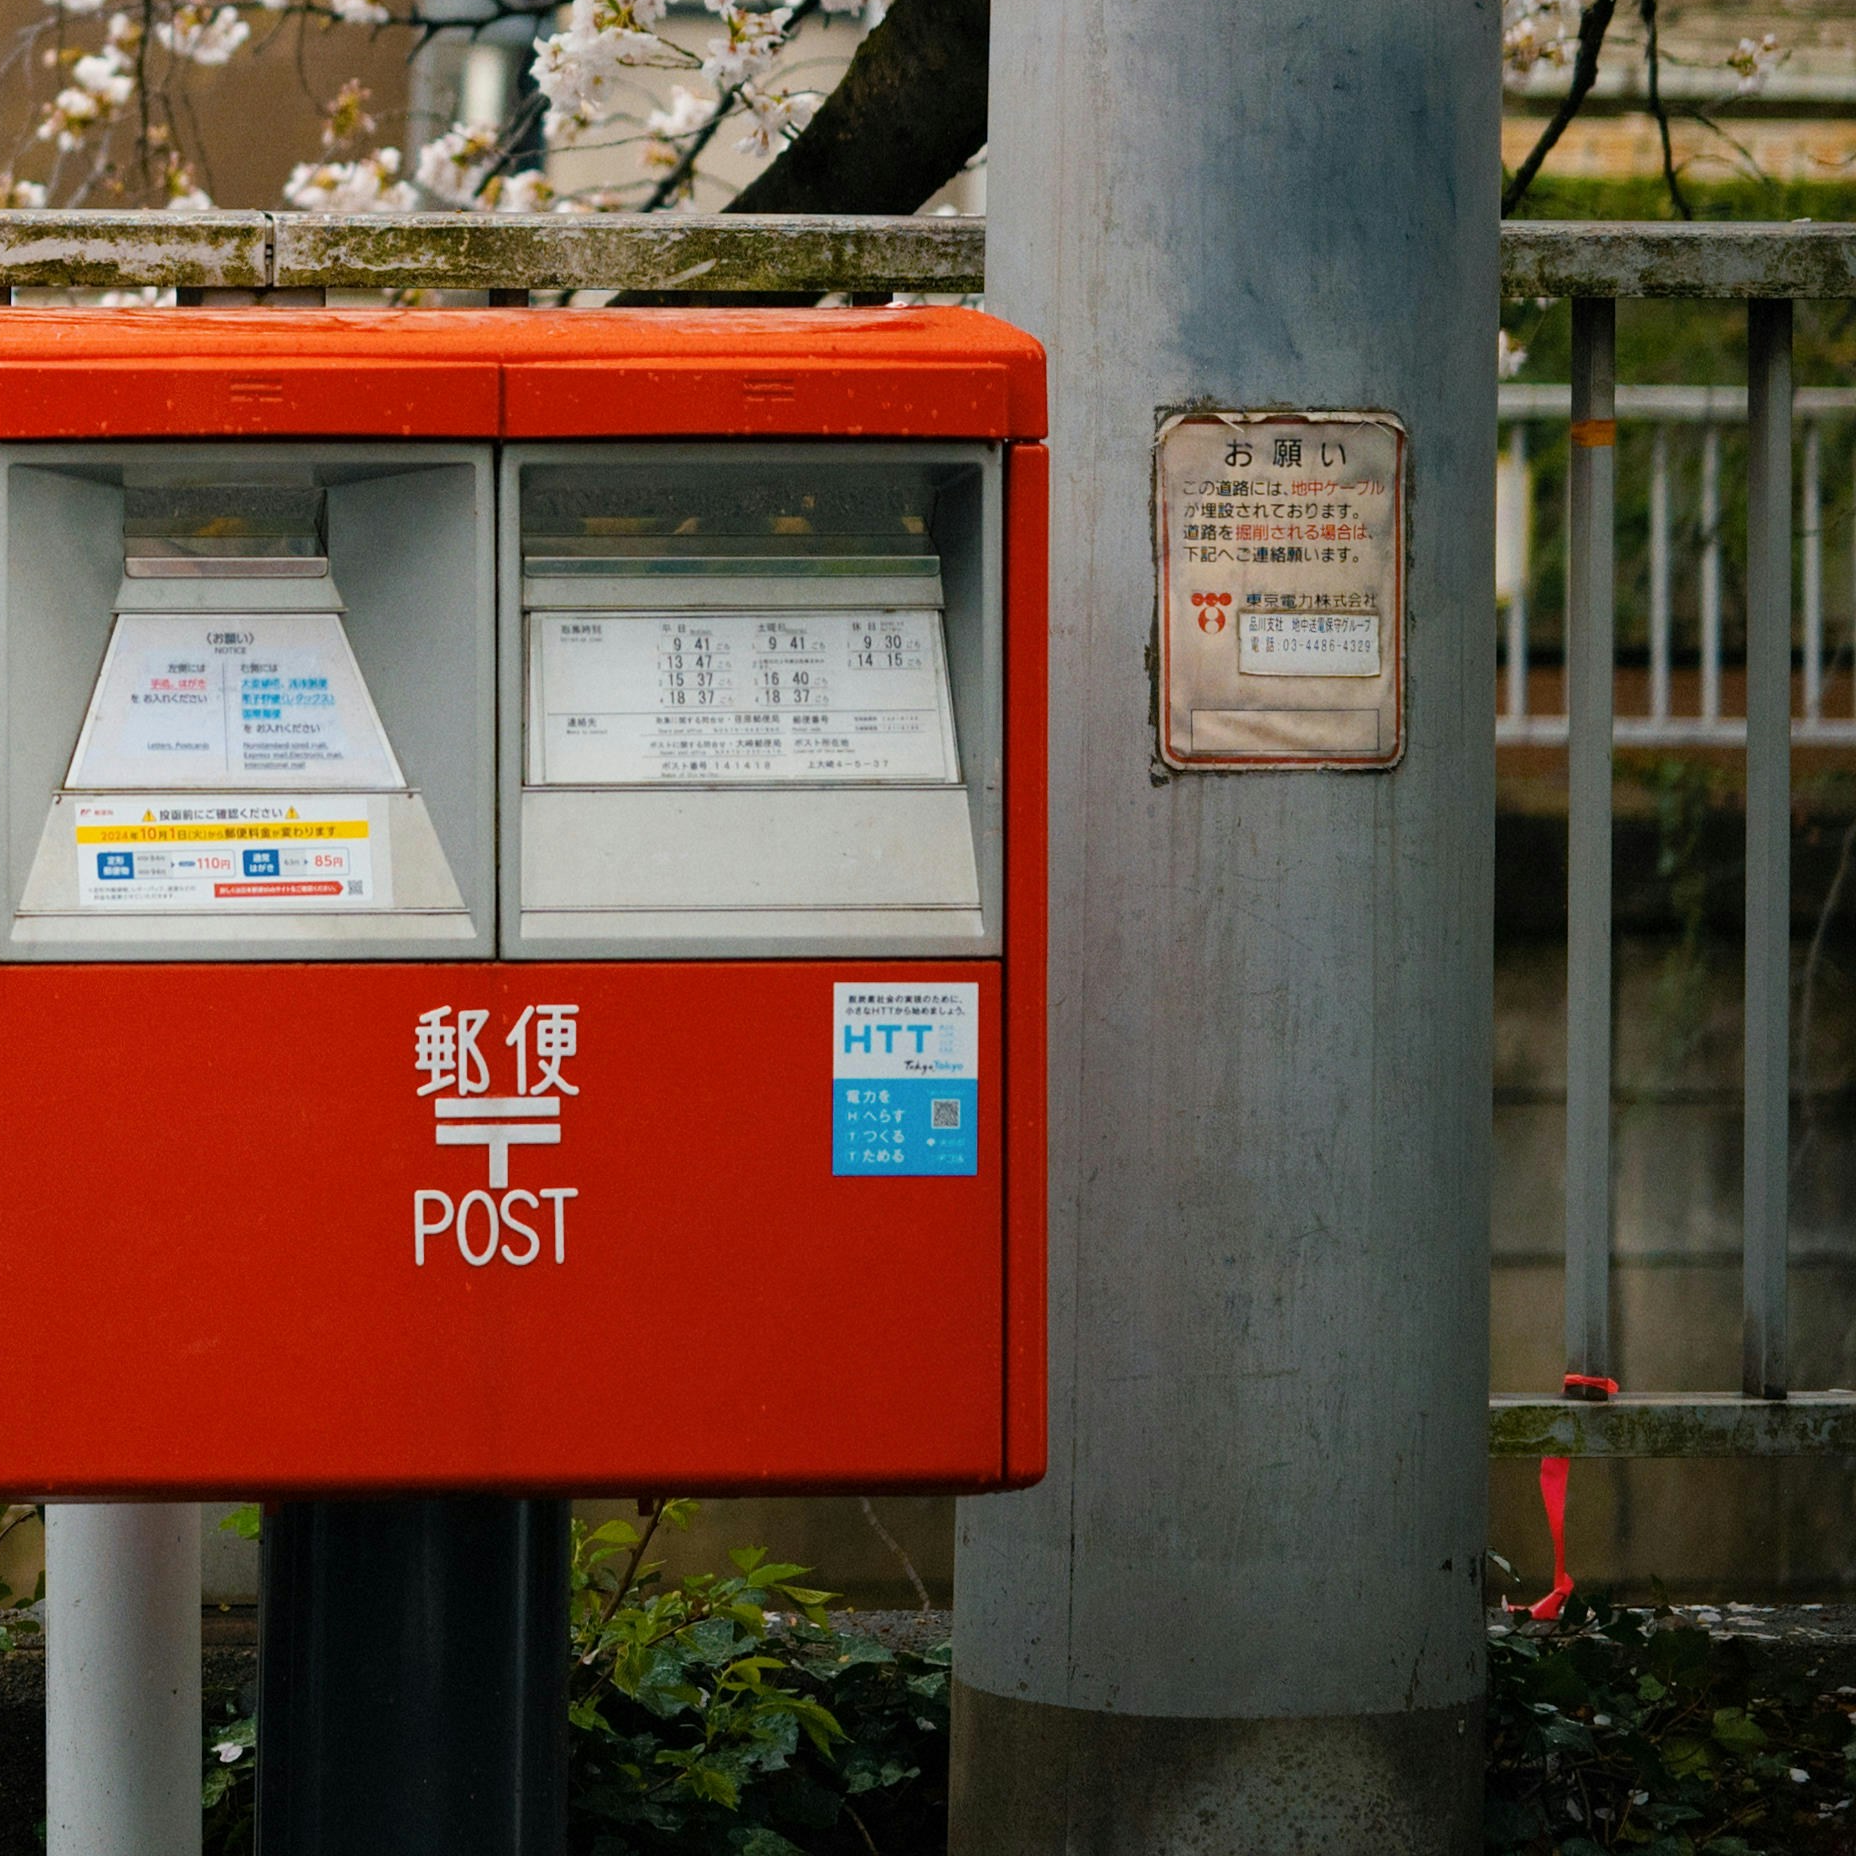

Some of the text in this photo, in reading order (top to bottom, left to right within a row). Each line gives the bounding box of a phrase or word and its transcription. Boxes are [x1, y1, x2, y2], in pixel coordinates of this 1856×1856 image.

[1225, 439, 1346, 468] お願い
[1182, 480, 1384, 497] この道路には、地中ケーブル
[1183, 502, 1360, 519] が埋設されております。
[1183, 524, 1374, 541] 道路を掘削される場合は、
[1183, 546, 1360, 563] 下記へご連絡願います。
[1246, 593, 1377, 608] 東京電力株式会社
[1248, 617, 1371, 632] 品川支社 地中送電保守グループ
[673, 638, 682, 651] 9
[694, 638, 710, 651] 41
[769, 637, 777, 650] 9
[790, 637, 805, 650] 41
[864, 636, 872, 649] 9
[885, 635, 902, 649] 30
[214, 647, 246, 655] NOTICE
[667, 656, 683, 669] 13
[696, 655, 712, 669] 47
[858, 654, 873, 667] 14
[888, 654, 903, 666] 15
[669, 673, 684, 687] 15
[697, 673, 713, 687] 37
[764, 672, 779, 685] 16
[793, 672, 809, 685] 40
[670, 691, 685, 705] 18
[698, 691, 714, 704] 37
[765, 690, 780, 703] 18
[794, 690, 810, 703] 37
[197, 857, 231, 870] 110円
[314, 855, 343, 867] 85円
[844, 1025, 933, 1054] HTT
[415, 1005, 579, 1097] 郵便
[863, 1109, 904, 1123] へらす
[863, 1130, 904, 1144] つくる
[863, 1149, 904, 1164] ためる
[414, 1188, 578, 1266] POST
